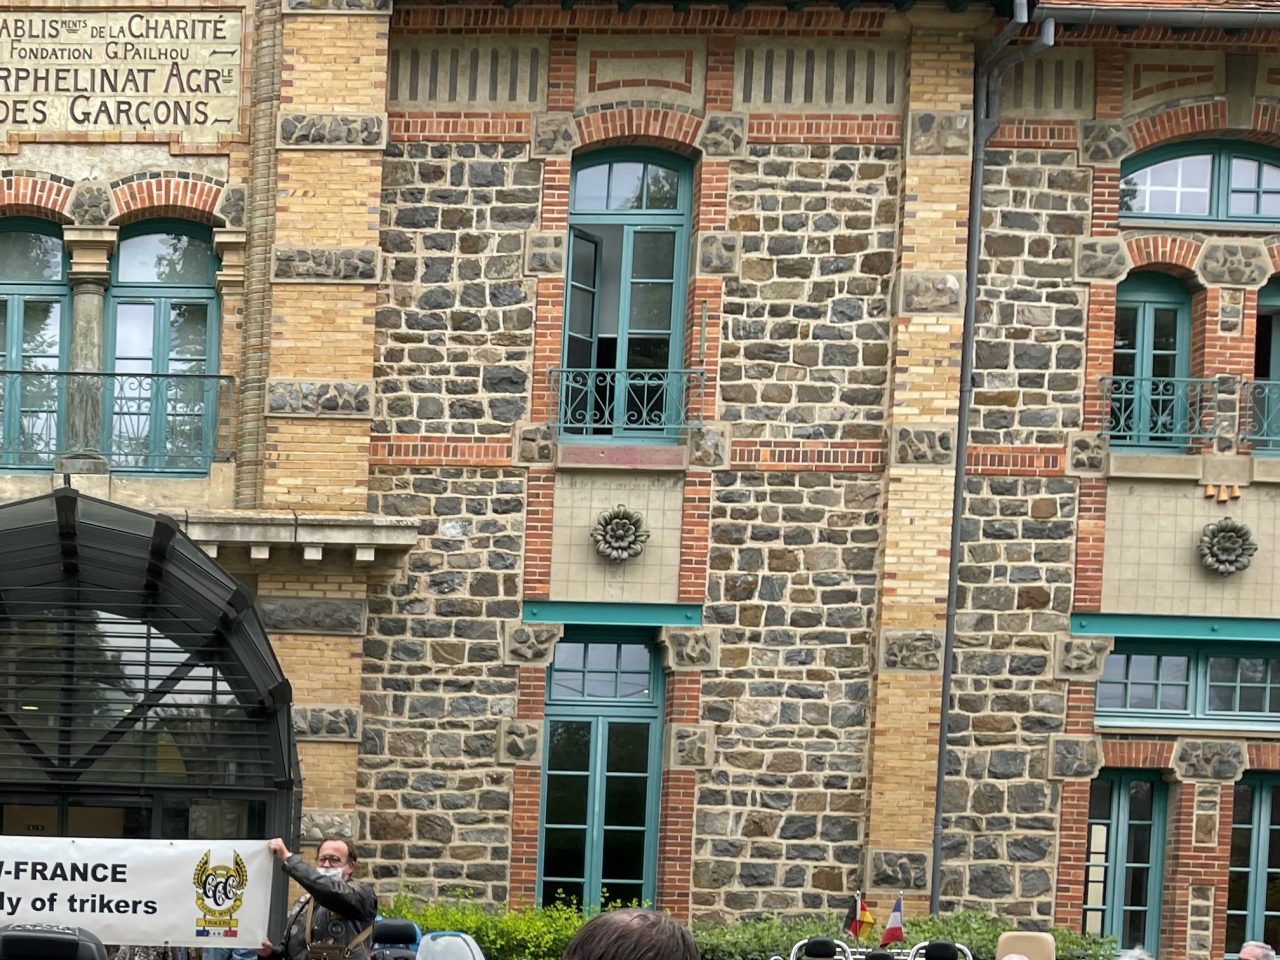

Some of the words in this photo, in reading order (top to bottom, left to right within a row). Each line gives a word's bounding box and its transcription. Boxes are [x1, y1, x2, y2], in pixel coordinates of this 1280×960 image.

[91, 26, 105, 38] DE
[109, 26, 126, 38] LA
[128, 14, 226, 39] CHARITÉ
[10, 39, 93, 60] FONDATION
[70, 95, 209, 130] GARÇONS
[31, 893, 58, 913] of
[67, 893, 158, 915] trikers
